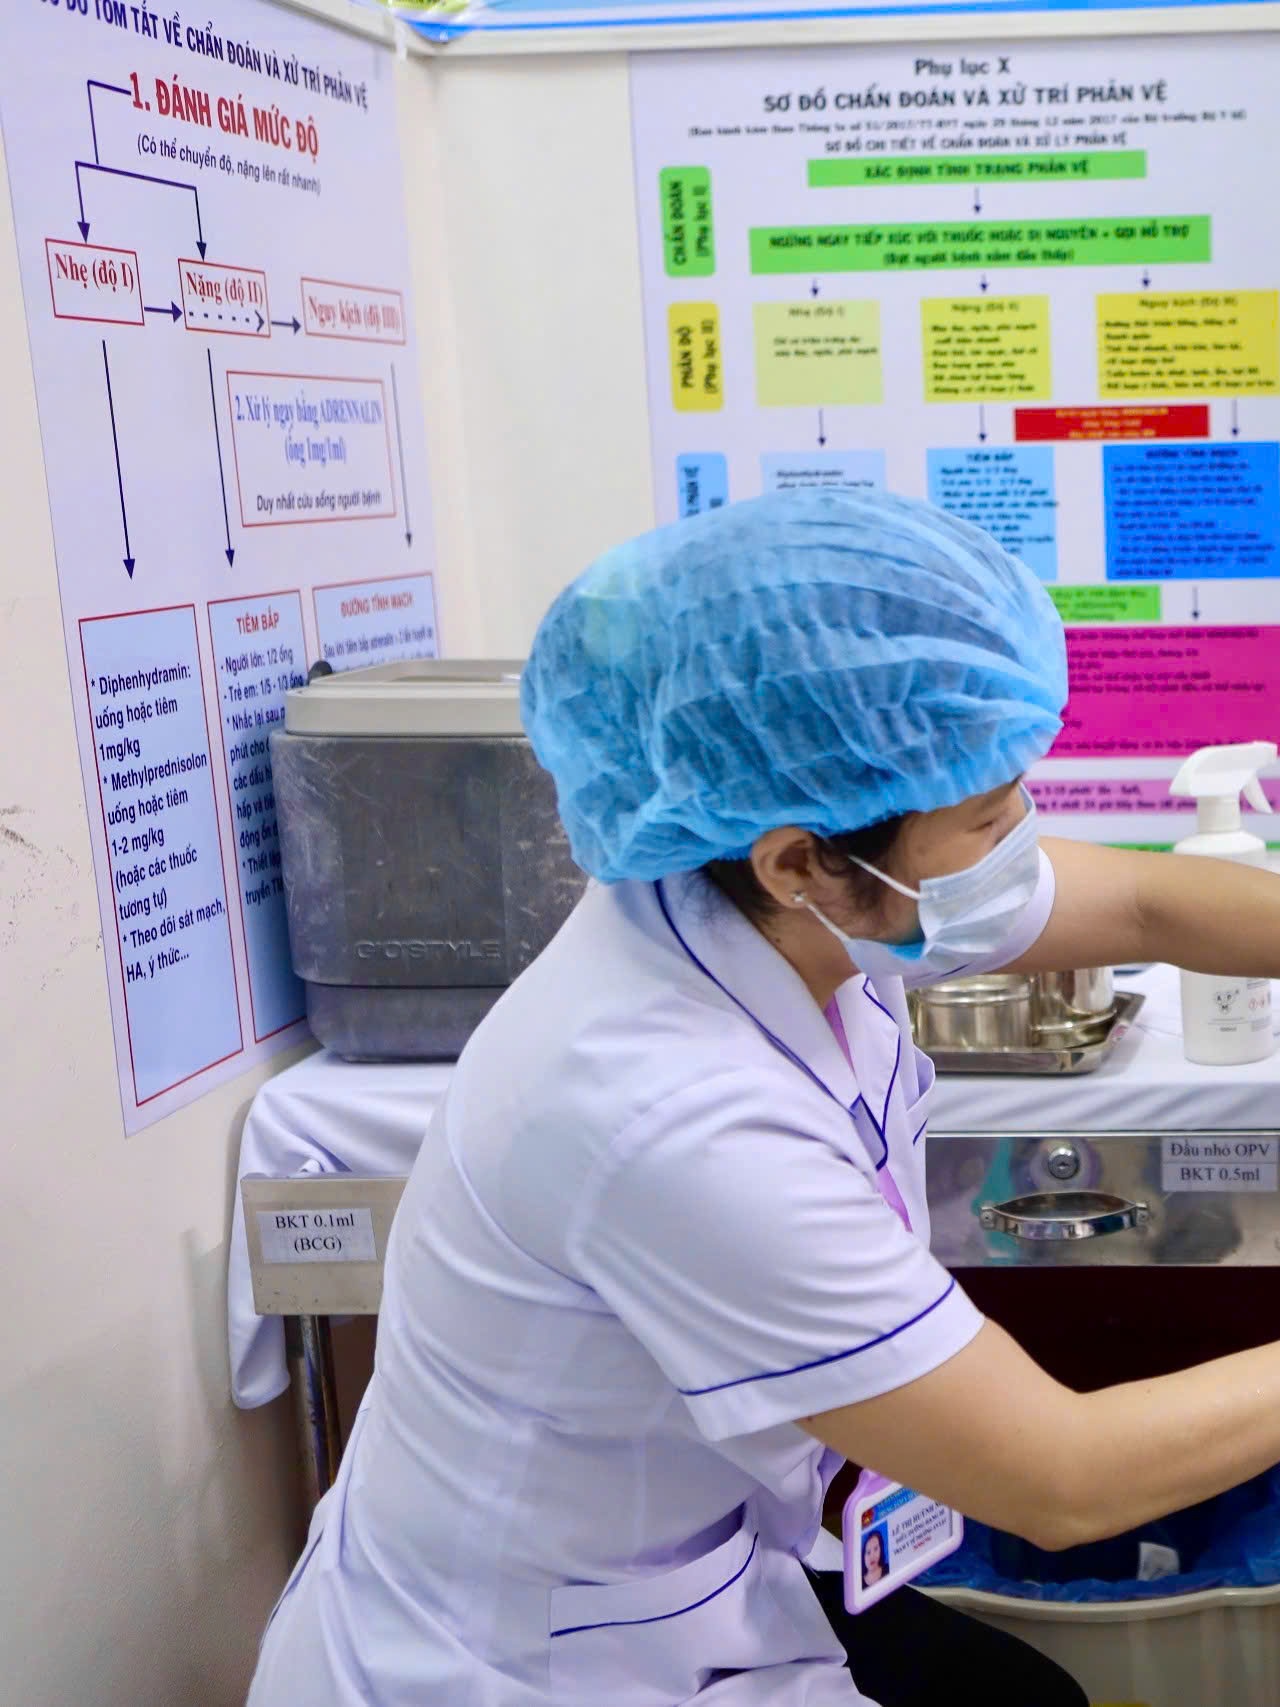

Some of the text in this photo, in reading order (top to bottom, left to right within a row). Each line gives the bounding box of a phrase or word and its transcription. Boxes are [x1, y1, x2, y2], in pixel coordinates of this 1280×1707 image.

[131, 1, 158, 39] TẮT
[163, 11, 182, 47] VỀ
[186, 21, 223, 61] CHẨN
[227, 41, 261, 74] ĐOÁN
[264, 51, 280, 80] VÀ
[283, 54, 299, 86] XỬ
[302, 66, 321, 93] TRÍ
[998, 57, 1010, 74] X
[964, 85, 989, 106] VÀ
[130, 72, 318, 163] 1. ĐÁNH GIÁ MỨC ĐỘ
[138, 134, 157, 156] (Có
[160, 137, 177, 159] thể
[180, 145, 216, 169] chuyển
[237, 160, 260, 183] nặng
[54, 253, 88, 287] Nhẹ
[93, 259, 117, 292] (độ
[186, 271, 222, 304] Nặng
[236, 613, 260, 635] TIÊM
[99, 663, 191, 697] Diphenhydramin:
[95, 697, 178, 730] uống hoặc tiêm
[99, 737, 141, 761] 1mg/kg
[111, 752, 207, 792] Methylprednisolon
[107, 788, 189, 826] uống hoặc tiêm
[112, 828, 165, 857] 1-2 mg/kg
[115, 843, 198, 893] (hoặc các thuốc
[119, 887, 167, 921] tương tự)
[130, 898, 226, 949] Theo dõi sát mạch,
[126, 961, 147, 984] HA,
[148, 953, 155, 977] ý
[1235, 1143, 1271, 1157] OPV
[1180, 1167, 1260, 1182] BKT 0.5ml
[275, 1213, 355, 1229] BKT 0.1ml
[294, 1236, 342, 1254] (BCG)
